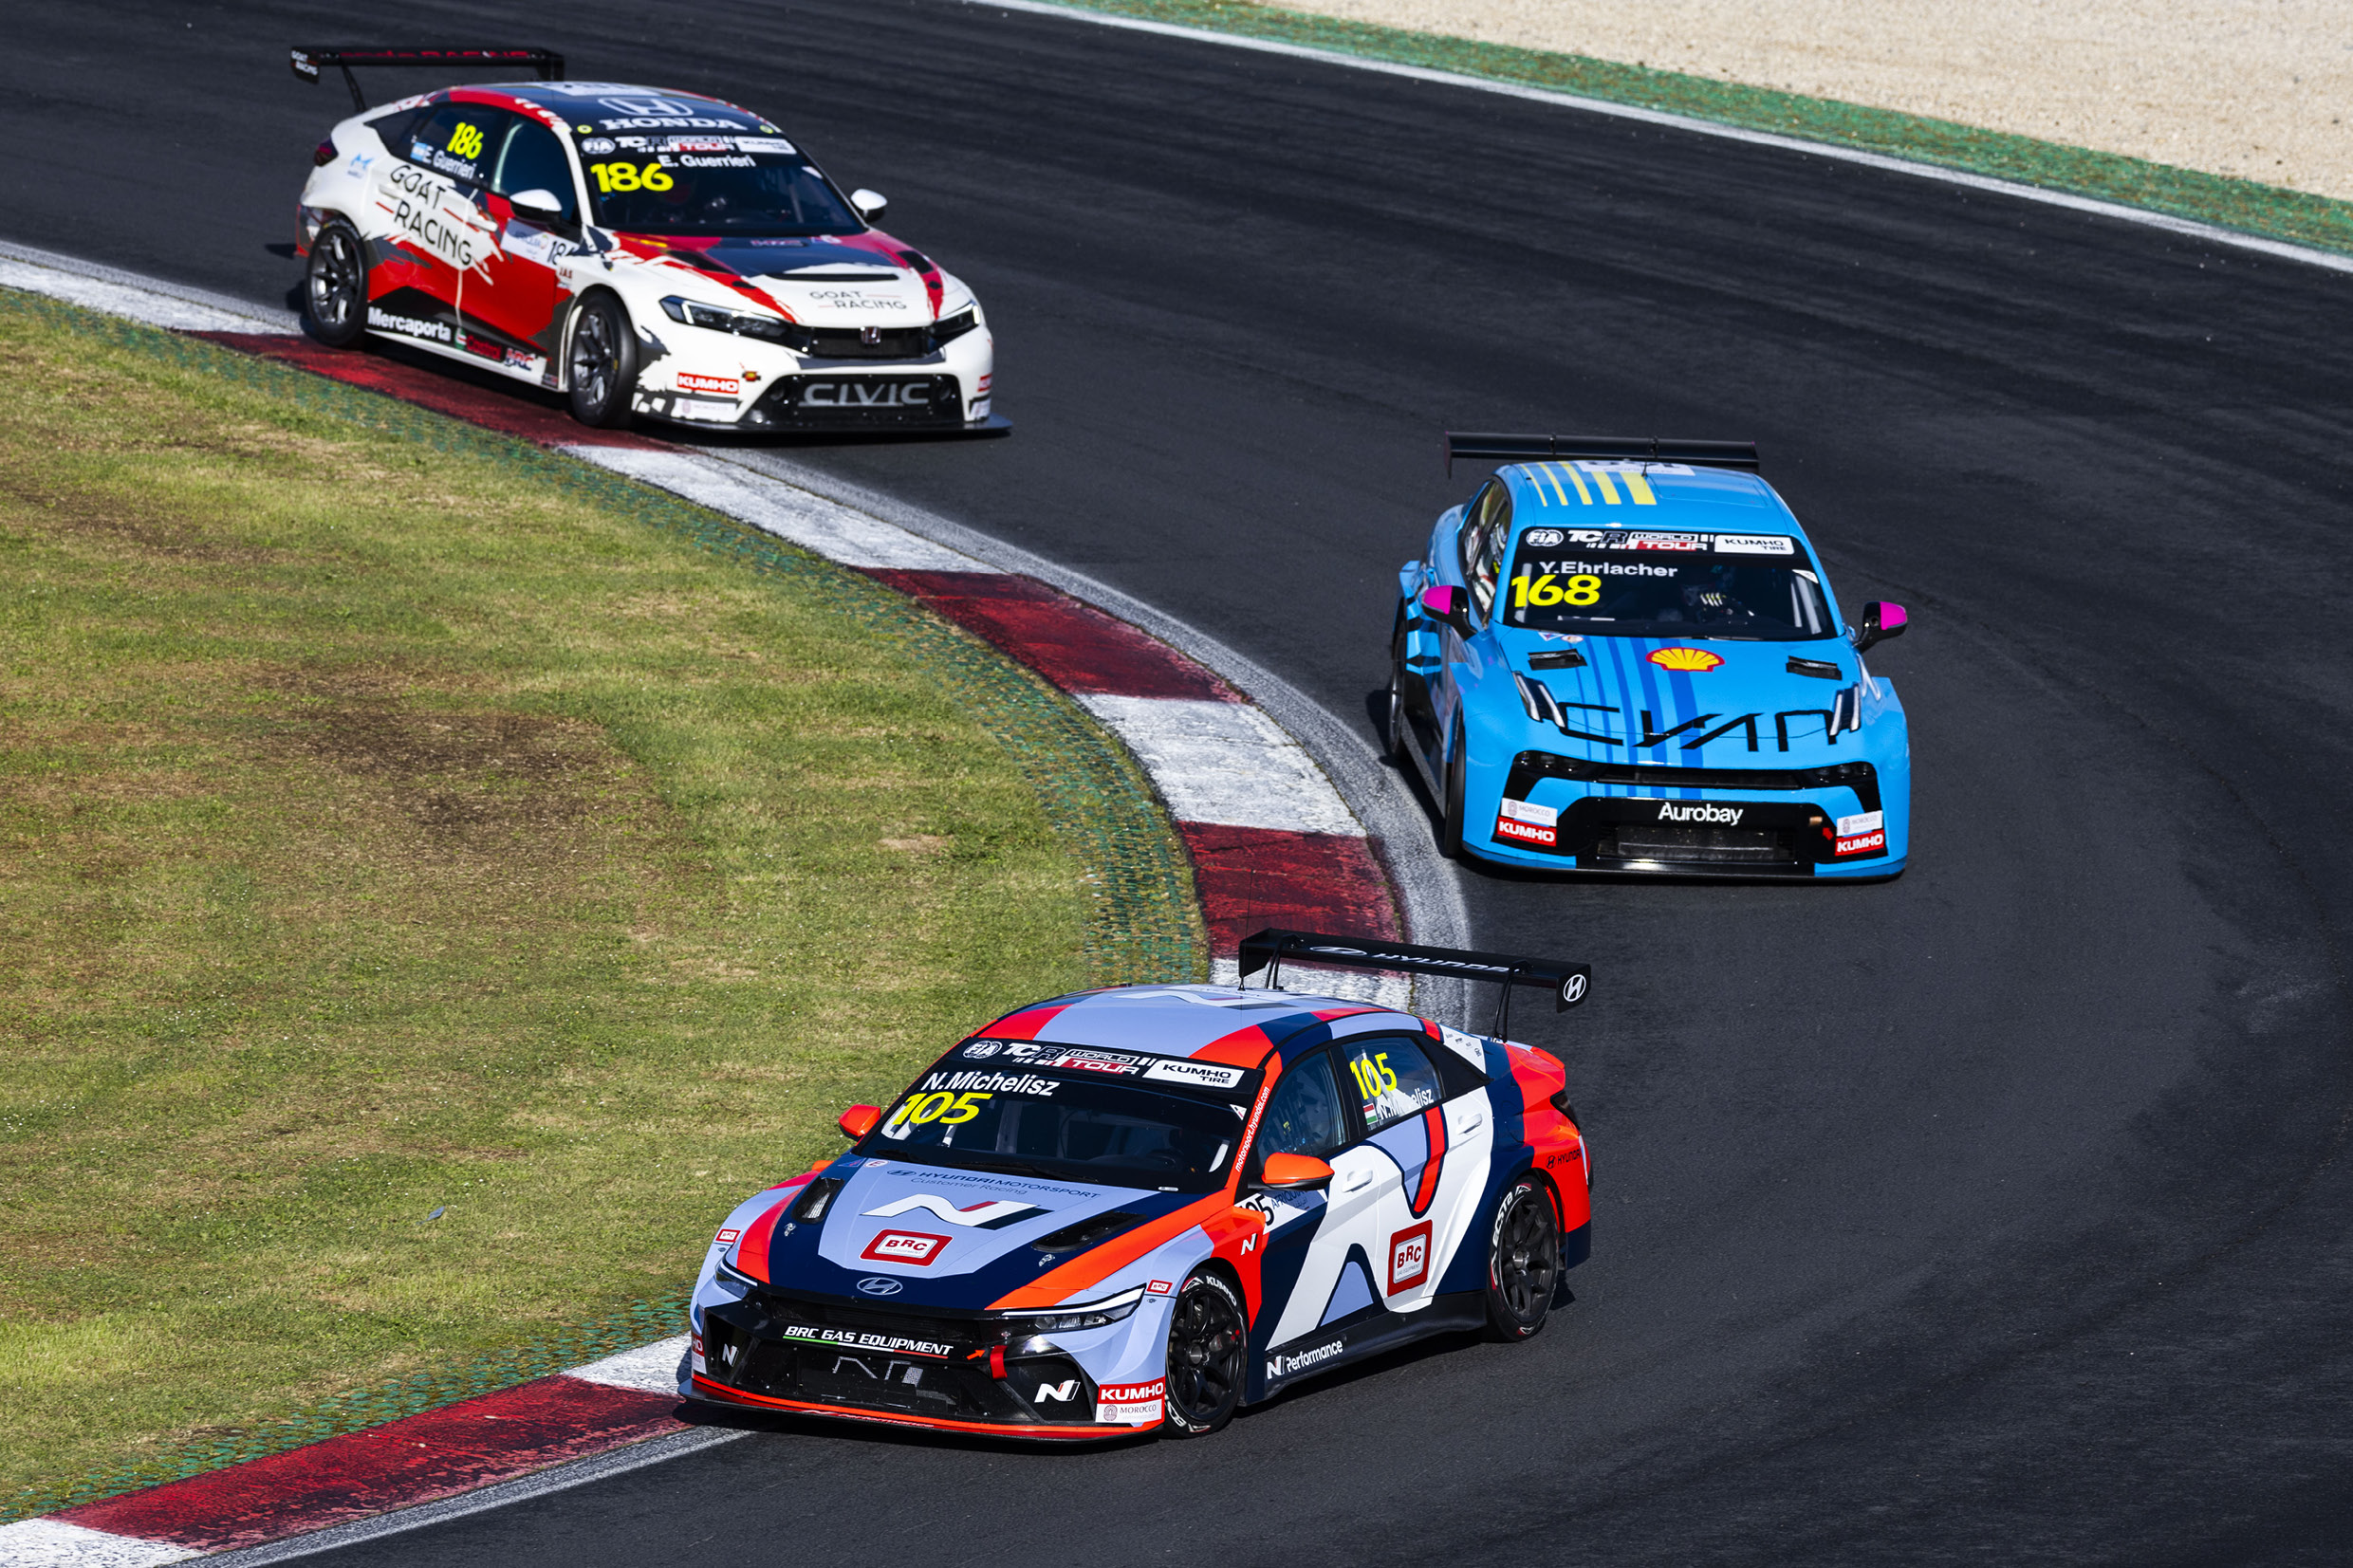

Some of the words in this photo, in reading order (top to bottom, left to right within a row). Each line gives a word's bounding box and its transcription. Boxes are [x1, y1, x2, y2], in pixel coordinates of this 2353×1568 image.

[599, 118, 748, 130] HONDA
[447, 121, 484, 159] 186
[583, 139, 615, 153] FIA
[615, 136, 666, 149] TCR
[679, 154, 756, 167] Guerrieri
[390, 164, 447, 210] GOAT
[590, 161, 674, 193] 186
[394, 199, 472, 266] RACING
[547, 240, 575, 266] 18
[809, 290, 862, 299] GOAT
[834, 300, 908, 309] RACING
[367, 306, 452, 342] Mercaporta
[677, 375, 738, 393] KUMHO
[804, 382, 930, 405] CIVIC
[1529, 531, 1560, 544] FIA
[1567, 529, 1628, 544] TCR
[1634, 533, 1693, 542] WORLD
[1724, 539, 1785, 547] KUMHO
[1643, 541, 1708, 551] TOUR
[1539, 561, 1678, 578] Y.Ehrlacher
[1511, 574, 1602, 608] 168
[1658, 802, 1744, 826] Aurobay
[1499, 821, 1555, 842] KUMHO
[1837, 834, 1883, 853] KUMHO
[965, 1042, 998, 1057] FIA
[1002, 1042, 1066, 1061] TCR
[1069, 1050, 1131, 1062] WORLD
[1162, 1064, 1232, 1079] KUMHO
[1073, 1060, 1140, 1075] TOUR
[1200, 1075, 1231, 1084] TIRE
[920, 1071, 1061, 1097] N.Michelisz
[1349, 1052, 1397, 1100] 105
[892, 1091, 993, 1124] 105
[1234, 1086, 1270, 1172] motorsport.hyundai.com
[911, 1177, 978, 1189] Customer
[978, 1185, 1028, 1195] Racing
[918, 1171, 995, 1184] HYUNDAI
[995, 1180, 1102, 1199] MOTORSPORT
[885, 1239, 927, 1251] BRC
[1397, 1245, 1422, 1269] BRC
[1206, 1275, 1237, 1307] KUMHO
[785, 1326, 819, 1338] BRC
[821, 1329, 857, 1343] GAS
[858, 1333, 954, 1356] EQUIPMENT
[1287, 1340, 1343, 1373] Performance
[1101, 1381, 1164, 1401] KUMHO
[1120, 1404, 1157, 1414] MOROCCO
